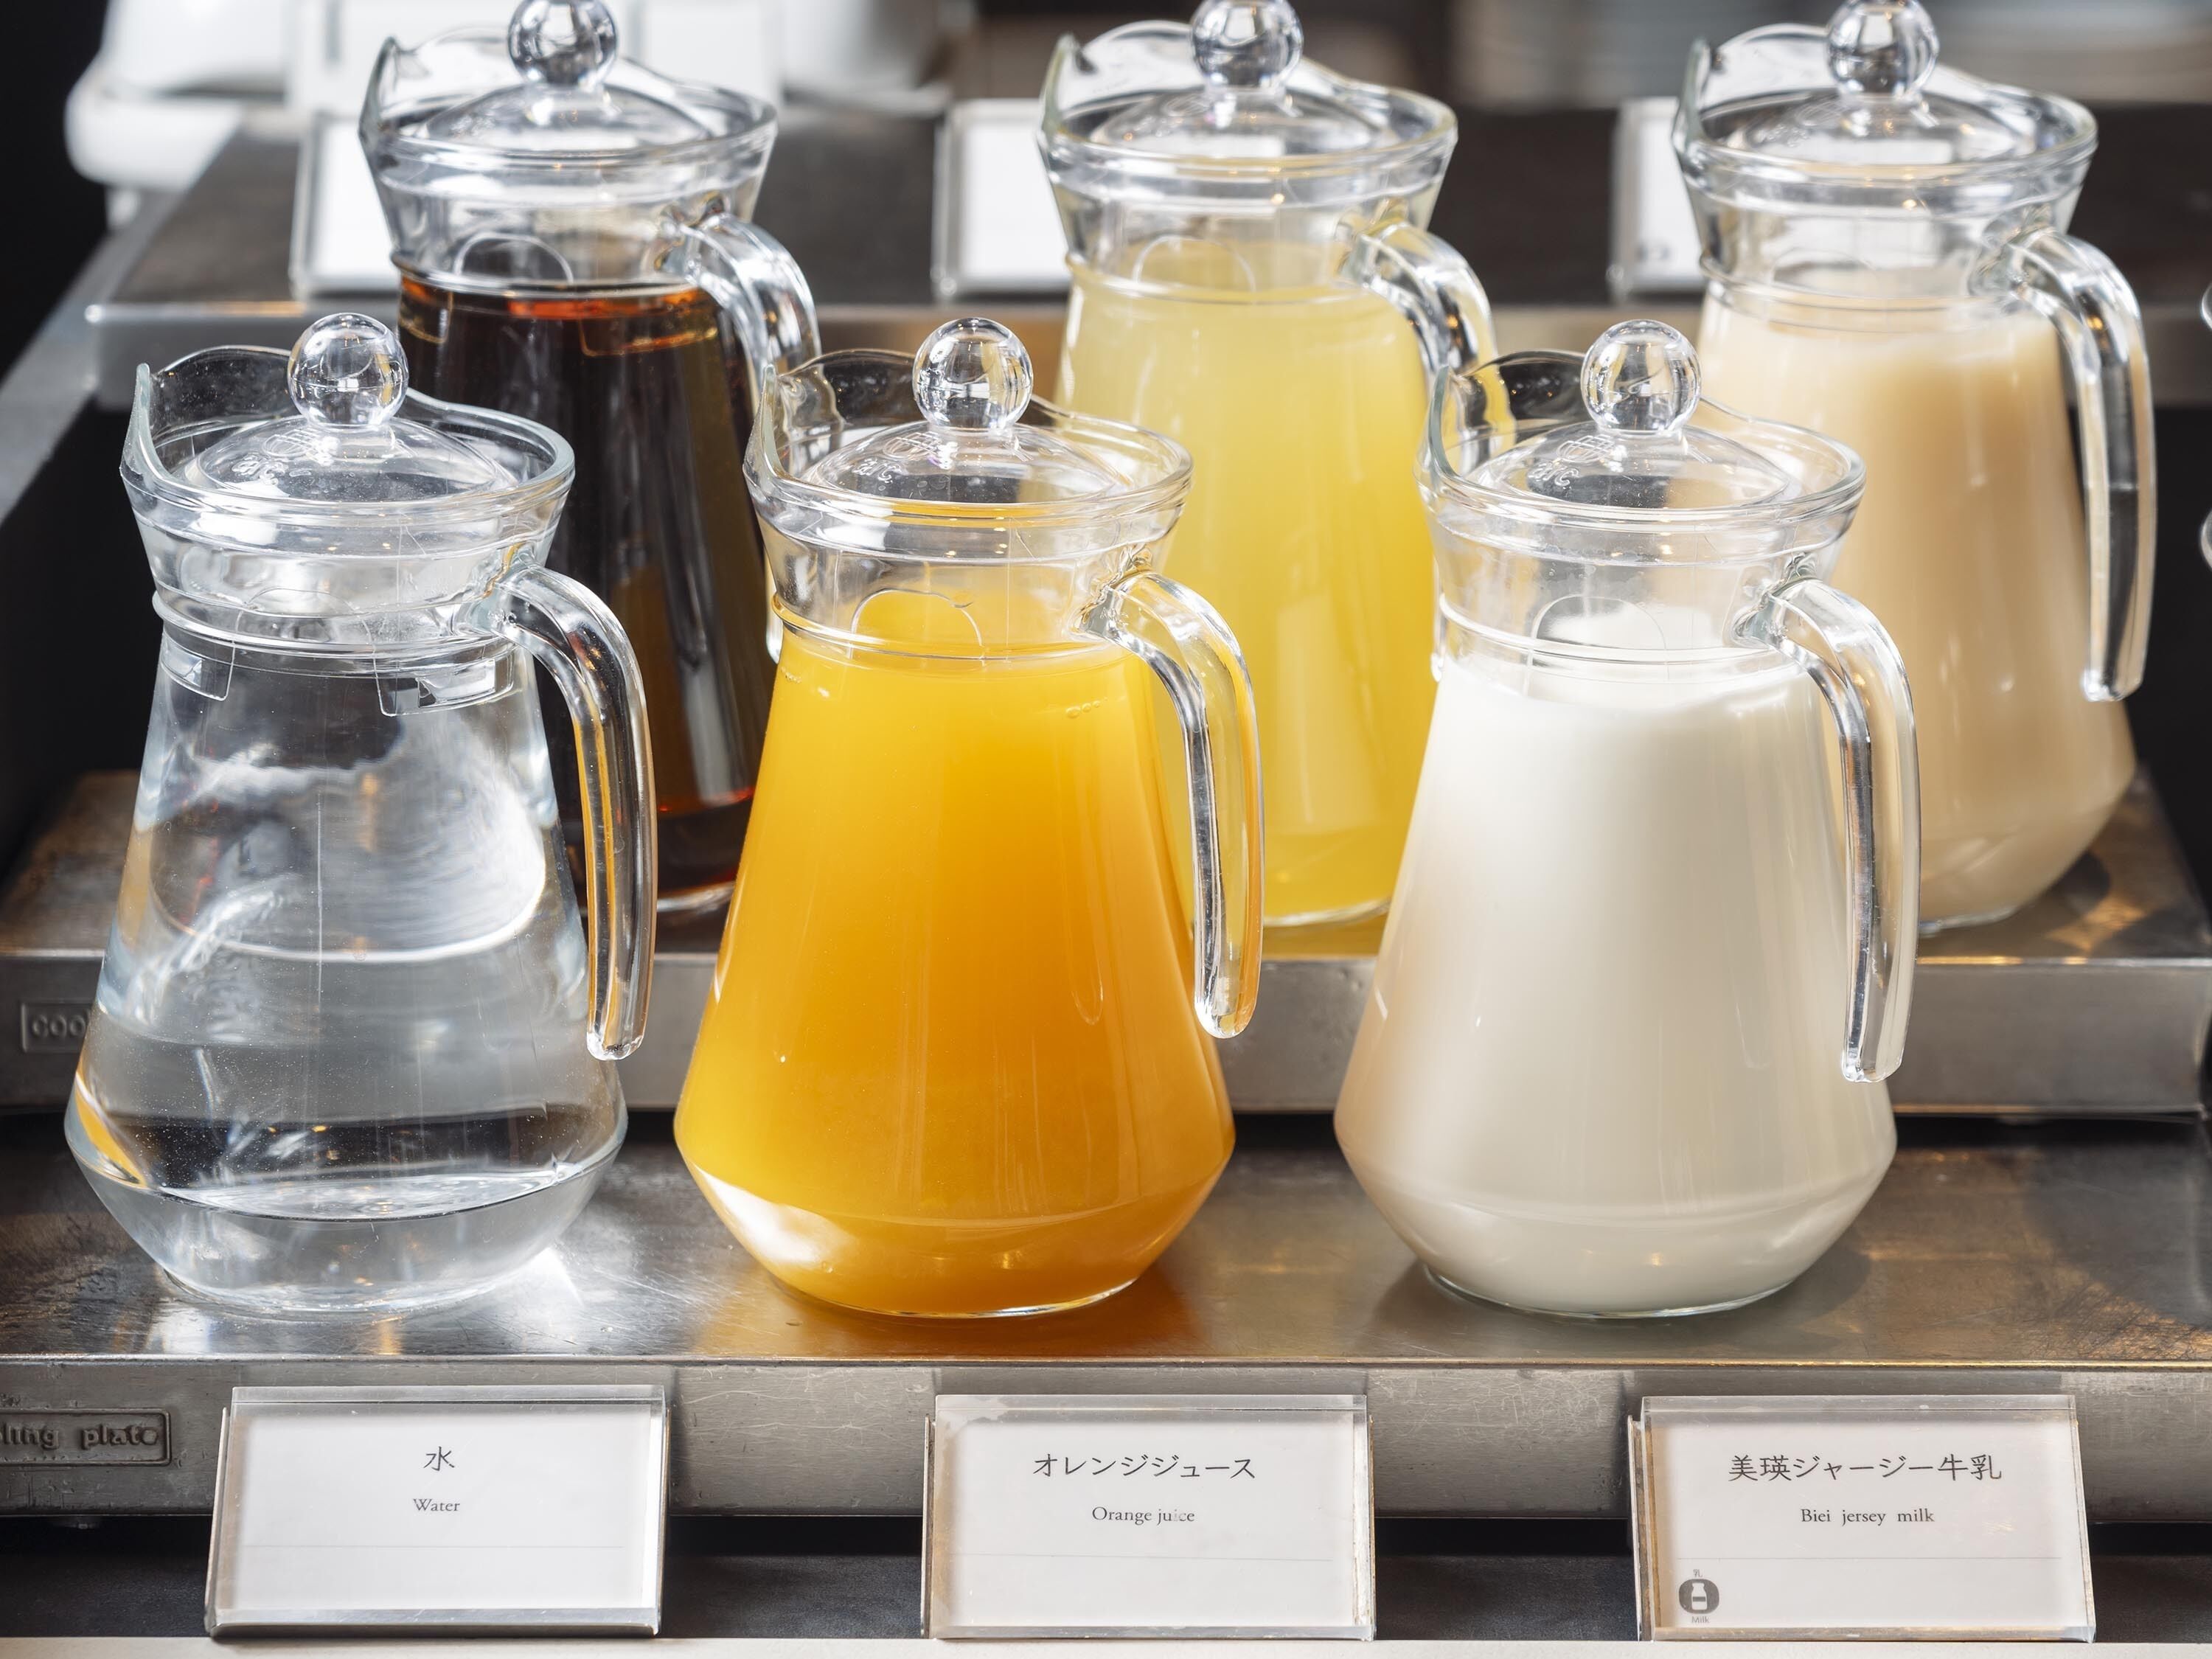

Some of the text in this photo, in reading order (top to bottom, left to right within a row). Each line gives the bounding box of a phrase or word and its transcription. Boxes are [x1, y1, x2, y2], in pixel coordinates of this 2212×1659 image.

[422, 1445, 455, 1472] 水
[1032, 1453, 1256, 1480] オレンジジュース
[1727, 1453, 2003, 1482] 美瑛ジャージー牛乳
[412, 1498, 461, 1512] Water
[1091, 1506, 1195, 1526] Orange juice
[1800, 1507, 1935, 1527] Biei jersey milk
[1692, 1568, 1703, 1578] 乳
[1691, 1615, 1711, 1624] Milk
